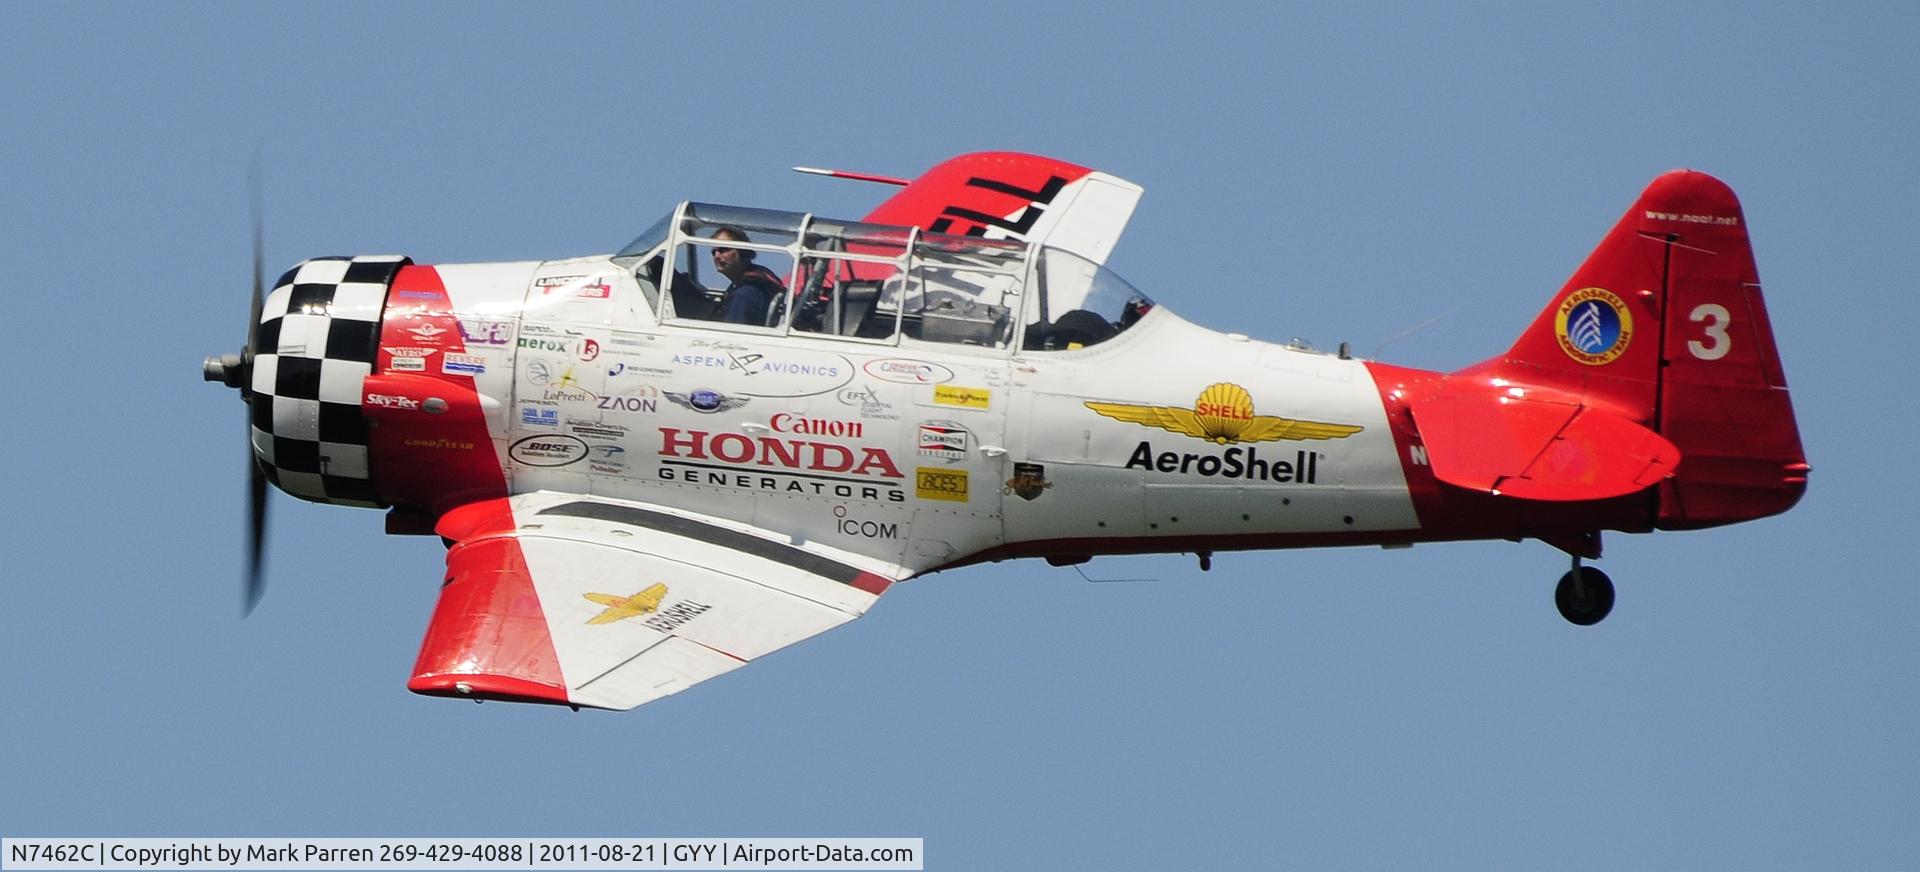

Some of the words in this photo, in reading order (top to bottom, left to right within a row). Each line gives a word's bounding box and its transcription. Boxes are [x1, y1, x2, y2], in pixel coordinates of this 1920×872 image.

[1562, 288, 1625, 315] AEROSHELL
[1687, 303, 1731, 360] 3
[517, 337, 566, 352] aerox
[672, 354, 725, 367] ASPEN
[763, 362, 839, 377] AVIONICS
[543, 389, 586, 402] LoPresti
[1198, 402, 1252, 420] SHELL
[769, 412, 863, 438] Canon
[528, 442, 574, 453] BOSE
[922, 433, 965, 446] CHAMPION
[658, 427, 905, 479] HONDA
[1126, 441, 1318, 485] AeroShell
[658, 467, 906, 502] GENERATORS
